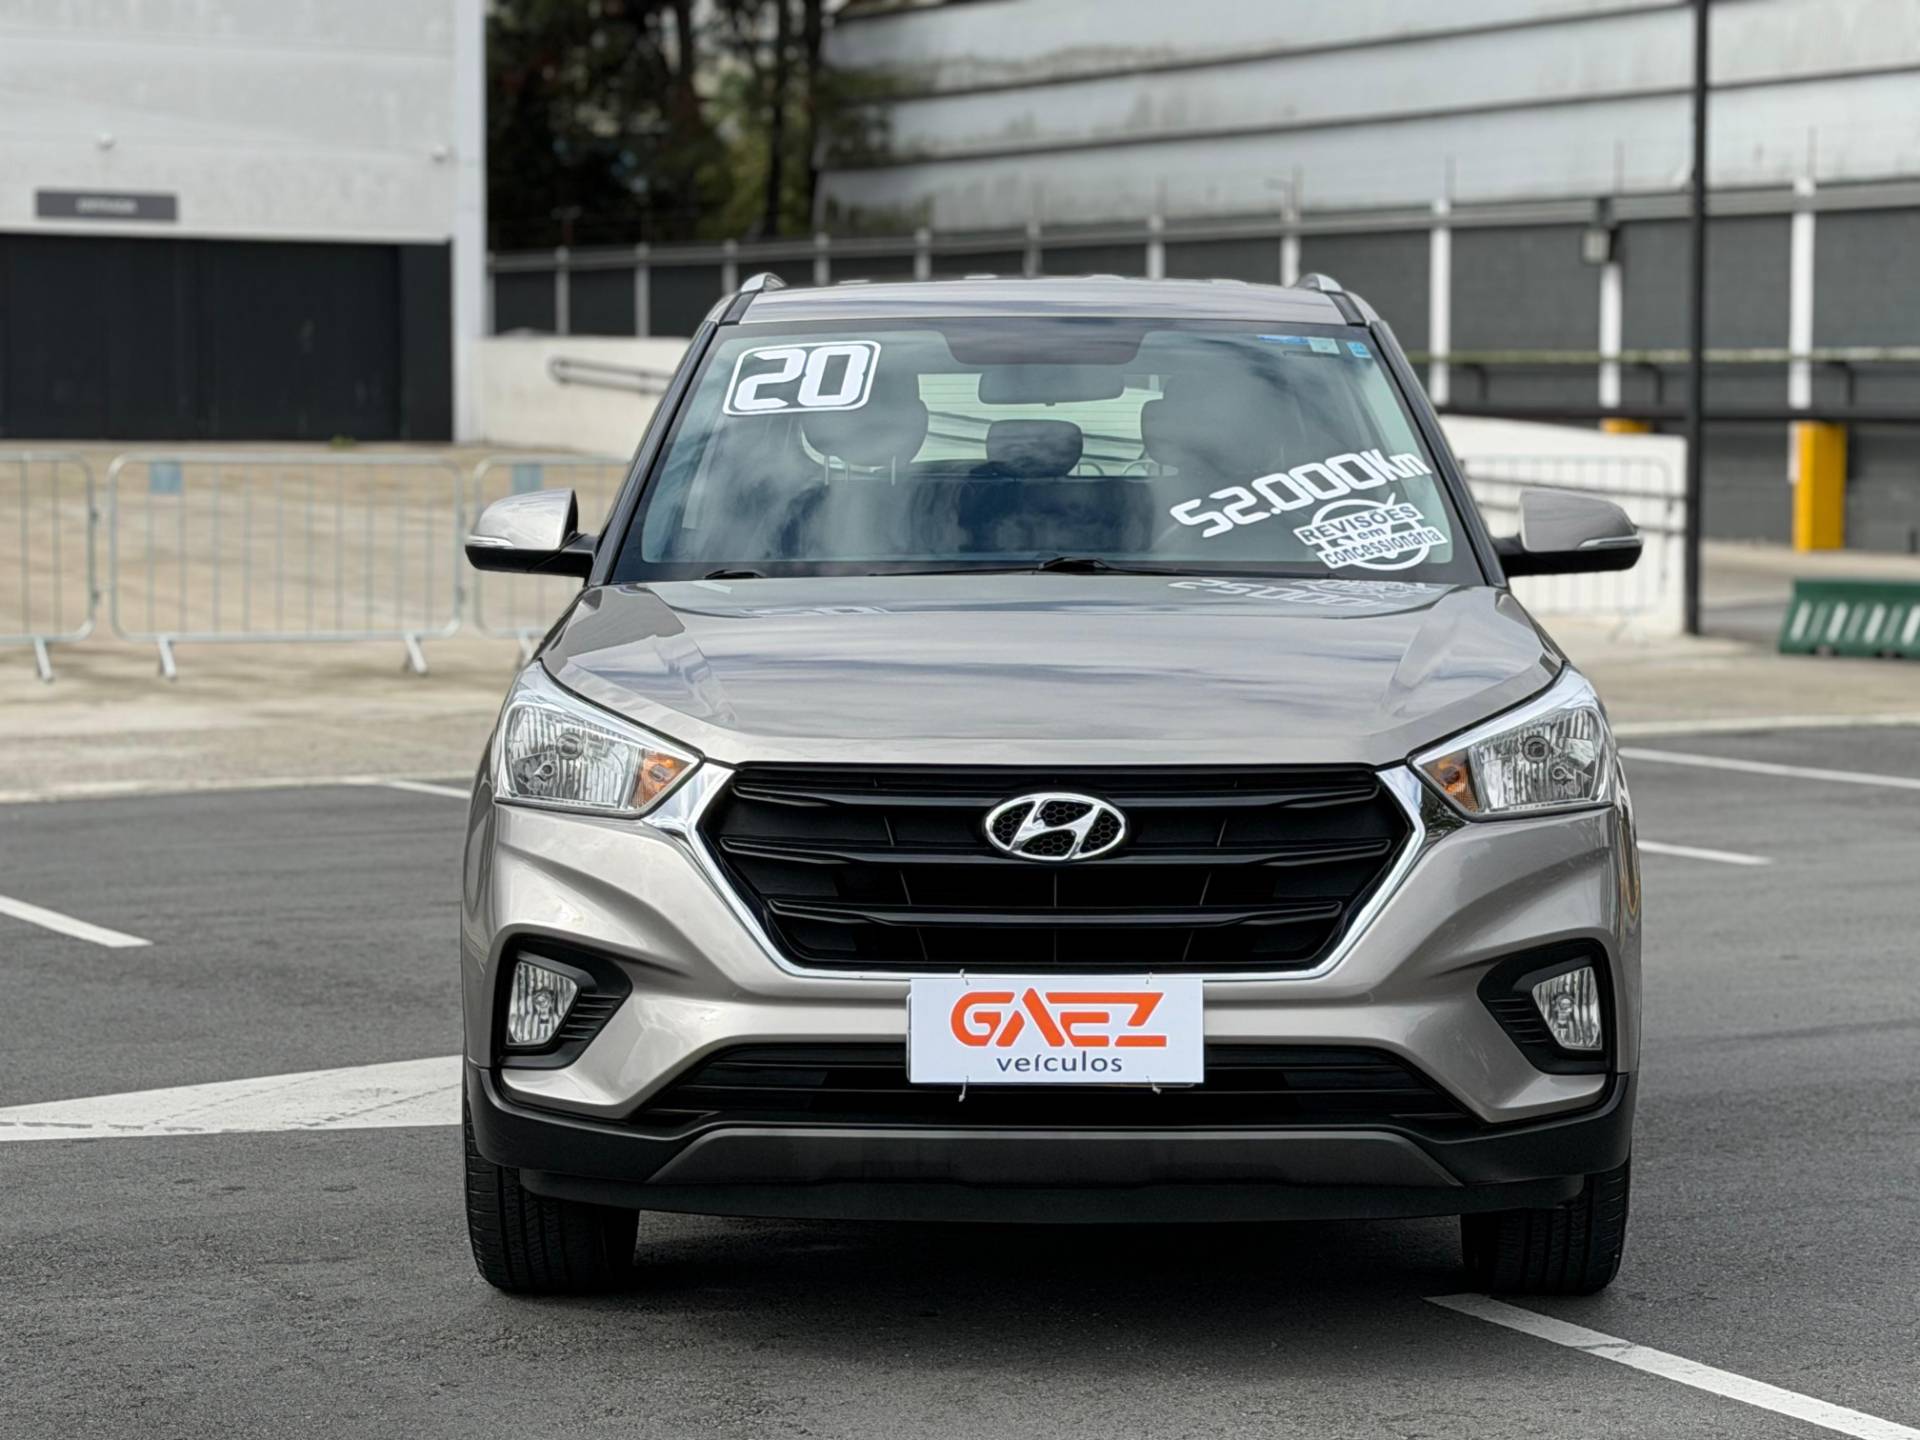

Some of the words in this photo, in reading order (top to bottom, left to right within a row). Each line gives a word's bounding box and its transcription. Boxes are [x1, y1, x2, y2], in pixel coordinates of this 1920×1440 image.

[734, 345, 870, 411] 20
[1299, 506, 1418, 543] REVISÕES
[1357, 526, 1387, 540] em
[950, 987, 1167, 1048] GAEZ
[996, 1050, 1124, 1073] veículos
